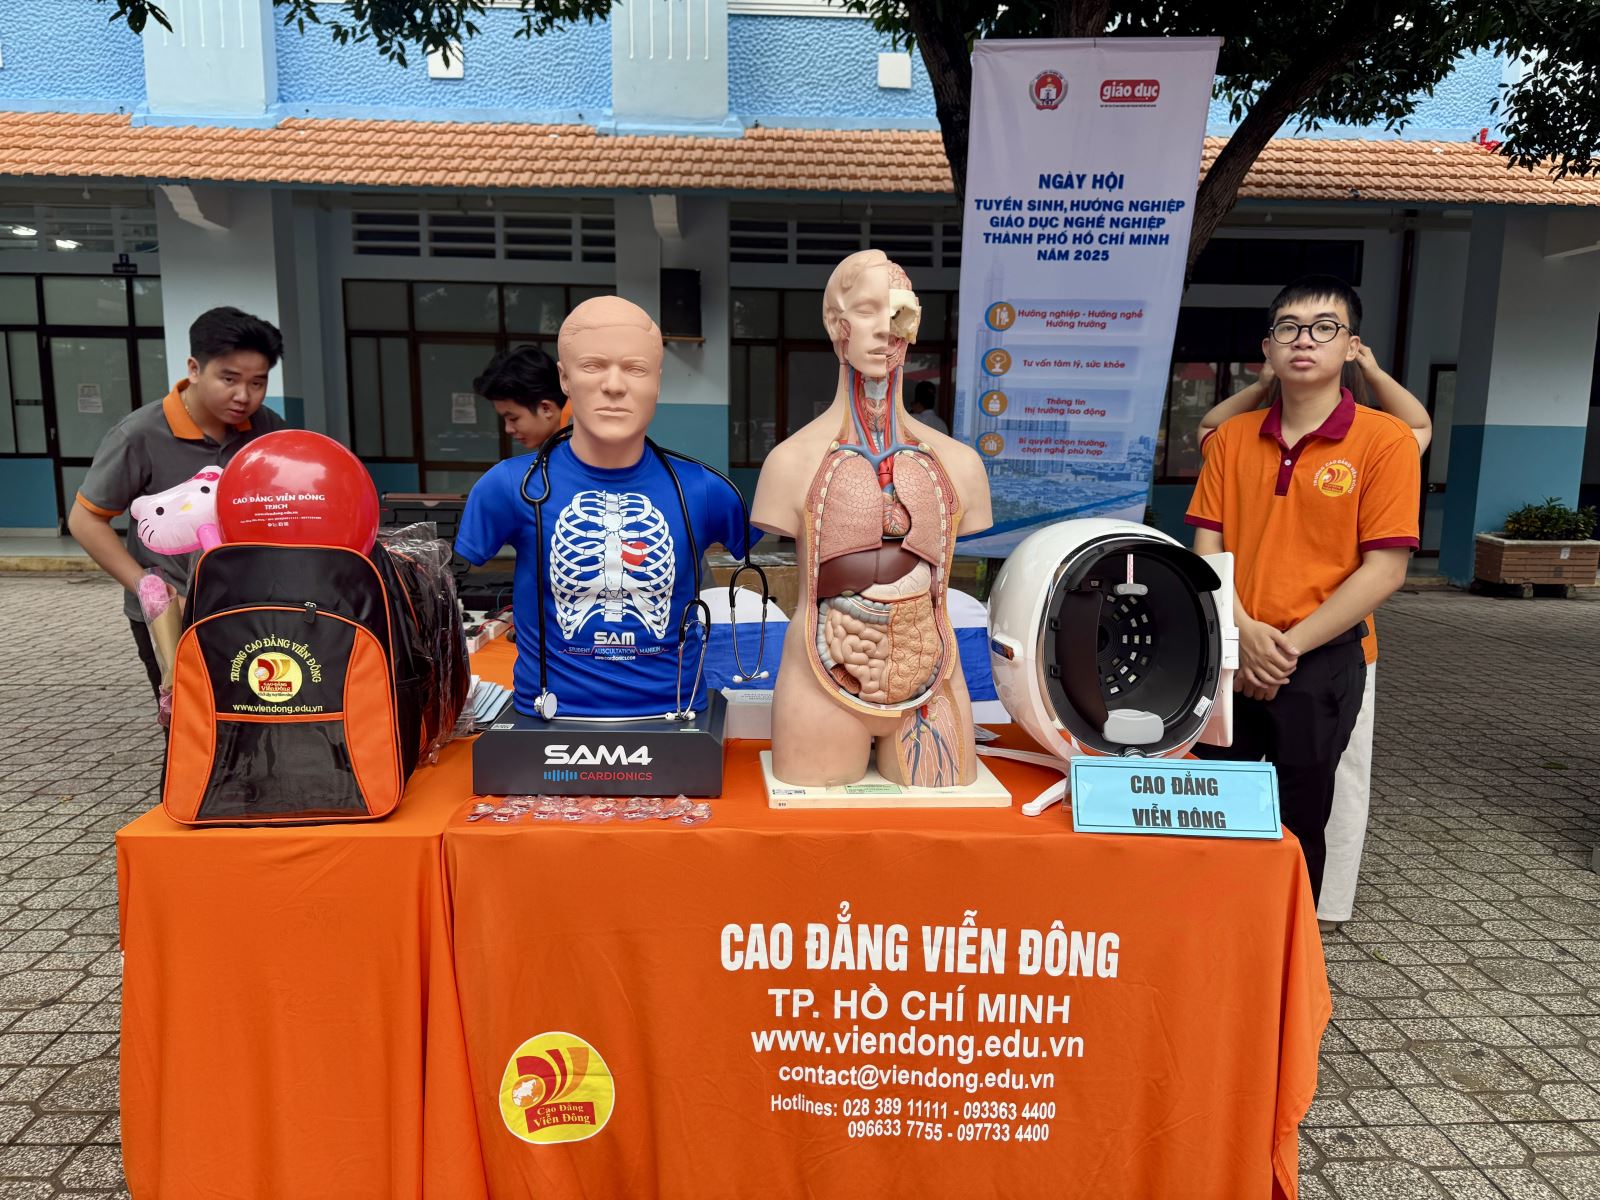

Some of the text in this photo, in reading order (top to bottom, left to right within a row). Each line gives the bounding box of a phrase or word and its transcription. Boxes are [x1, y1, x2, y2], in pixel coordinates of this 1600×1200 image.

[1102, 81, 1159, 100] giáo dục
[1038, 171, 1125, 192] NGÀY HỘI
[1026, 199, 1068, 214] SINH,
[1070, 197, 1124, 212] HƯỚNG
[1128, 198, 1185, 215] NGHIỆP
[989, 214, 1024, 228] GIÁO
[1028, 216, 1059, 231] DỤC
[1109, 215, 1166, 231] NGHIỆP
[983, 229, 1170, 246] THÀNH PHỐ HỒ CHÍ MINH
[1036, 247, 1110, 261] NĂM 2025
[1018, 309, 1047, 319] Hướng
[1049, 309, 1080, 320] nghiệp
[1088, 310, 1118, 320] Hướng
[1046, 319, 1075, 329] Hướng
[1023, 359, 1034, 367] Tư
[1035, 358, 1051, 367] vấn
[1054, 359, 1071, 367] tâm
[1086, 359, 1101, 368] sức
[1046, 397, 1086, 407] Thông tin
[1024, 406, 1035, 416] thị
[1067, 407, 1081, 415] lao
[1083, 407, 1106, 417] động
[1021, 445, 1042, 454] chọn
[1054, 438, 1076, 447] chọn
[232, 497, 248, 505] CAO
[298, 492, 325, 501] ĐÔNG
[593, 631, 635, 645] SAM
[244, 640, 263, 653] CAO
[291, 642, 312, 661] VIỄN
[306, 657, 322, 684] ĐÔNG
[232, 704, 323, 714] www.viendong.edu.vn
[543, 744, 653, 766] SAM4
[580, 771, 653, 781] CARDIONICS
[1130, 770, 1219, 796] CAO ĐẲNG
[1132, 803, 1227, 829] VIỄN ĐÔNG
[720, 900, 1121, 979] CAO ĐẲNG VIỄN ĐÔNG
[767, 982, 1071, 1025] TP. HỒ CHÍ MINH
[751, 1024, 1085, 1065] www.viendong.edu.vn
[778, 1063, 1055, 1093] contact@viendong.edu.vn
[536, 1105, 557, 1116] Cao
[770, 1094, 838, 1118] Hotlines:
[842, 1098, 870, 1117] 028
[874, 1098, 902, 1117] 389
[907, 1099, 948, 1120] 11111
[963, 1101, 1018, 1120] 093363
[1021, 1101, 1056, 1120] 4400
[533, 1113, 590, 1128] Viễn Đông
[847, 1119, 902, 1139] 096633
[906, 1120, 943, 1141] 7755
[957, 1123, 1011, 1142] 097733
[1014, 1123, 1050, 1142] 4400
